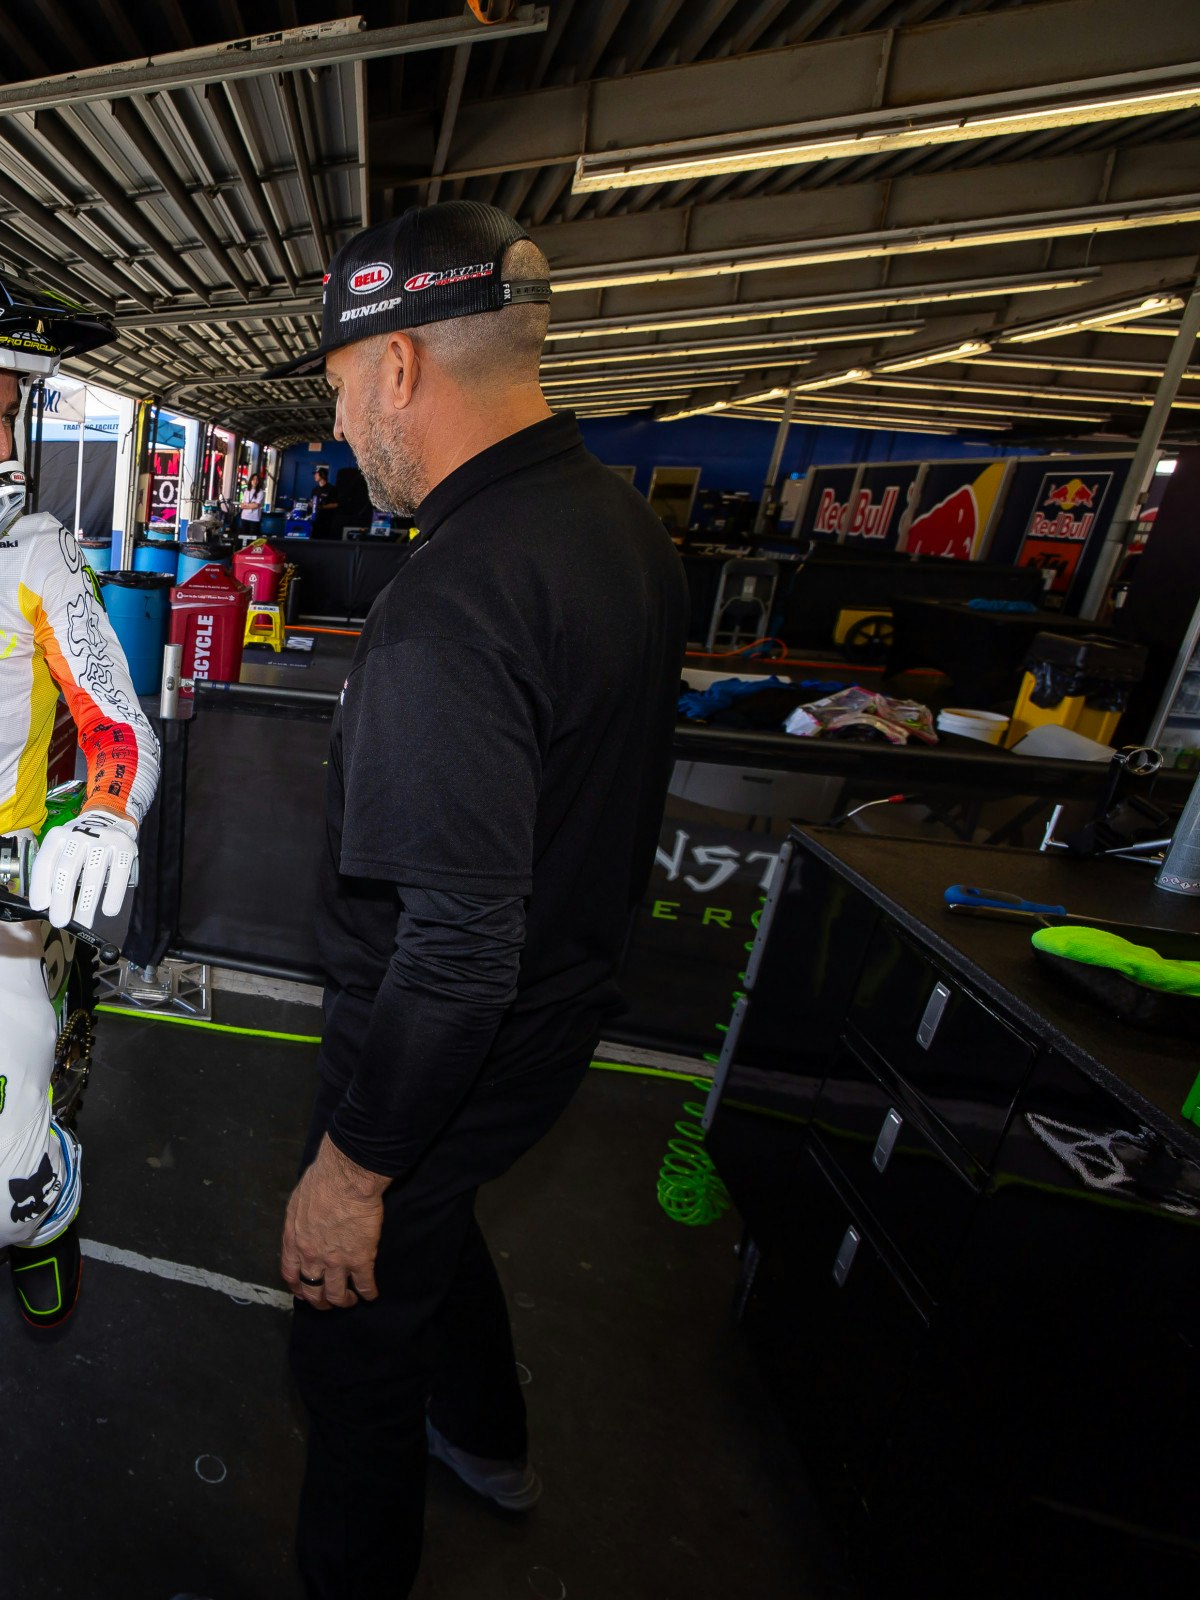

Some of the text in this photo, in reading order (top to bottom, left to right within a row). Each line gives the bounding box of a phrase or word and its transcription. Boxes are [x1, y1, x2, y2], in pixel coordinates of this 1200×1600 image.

[354, 270, 385, 287] BELL
[503, 283, 511, 300] FOX
[340, 297, 402, 322] DUNLOP
[848, 485, 900, 539] Bull
[1027, 511, 1096, 541] Red Bull
[192, 614, 214, 682] ECYCLE
